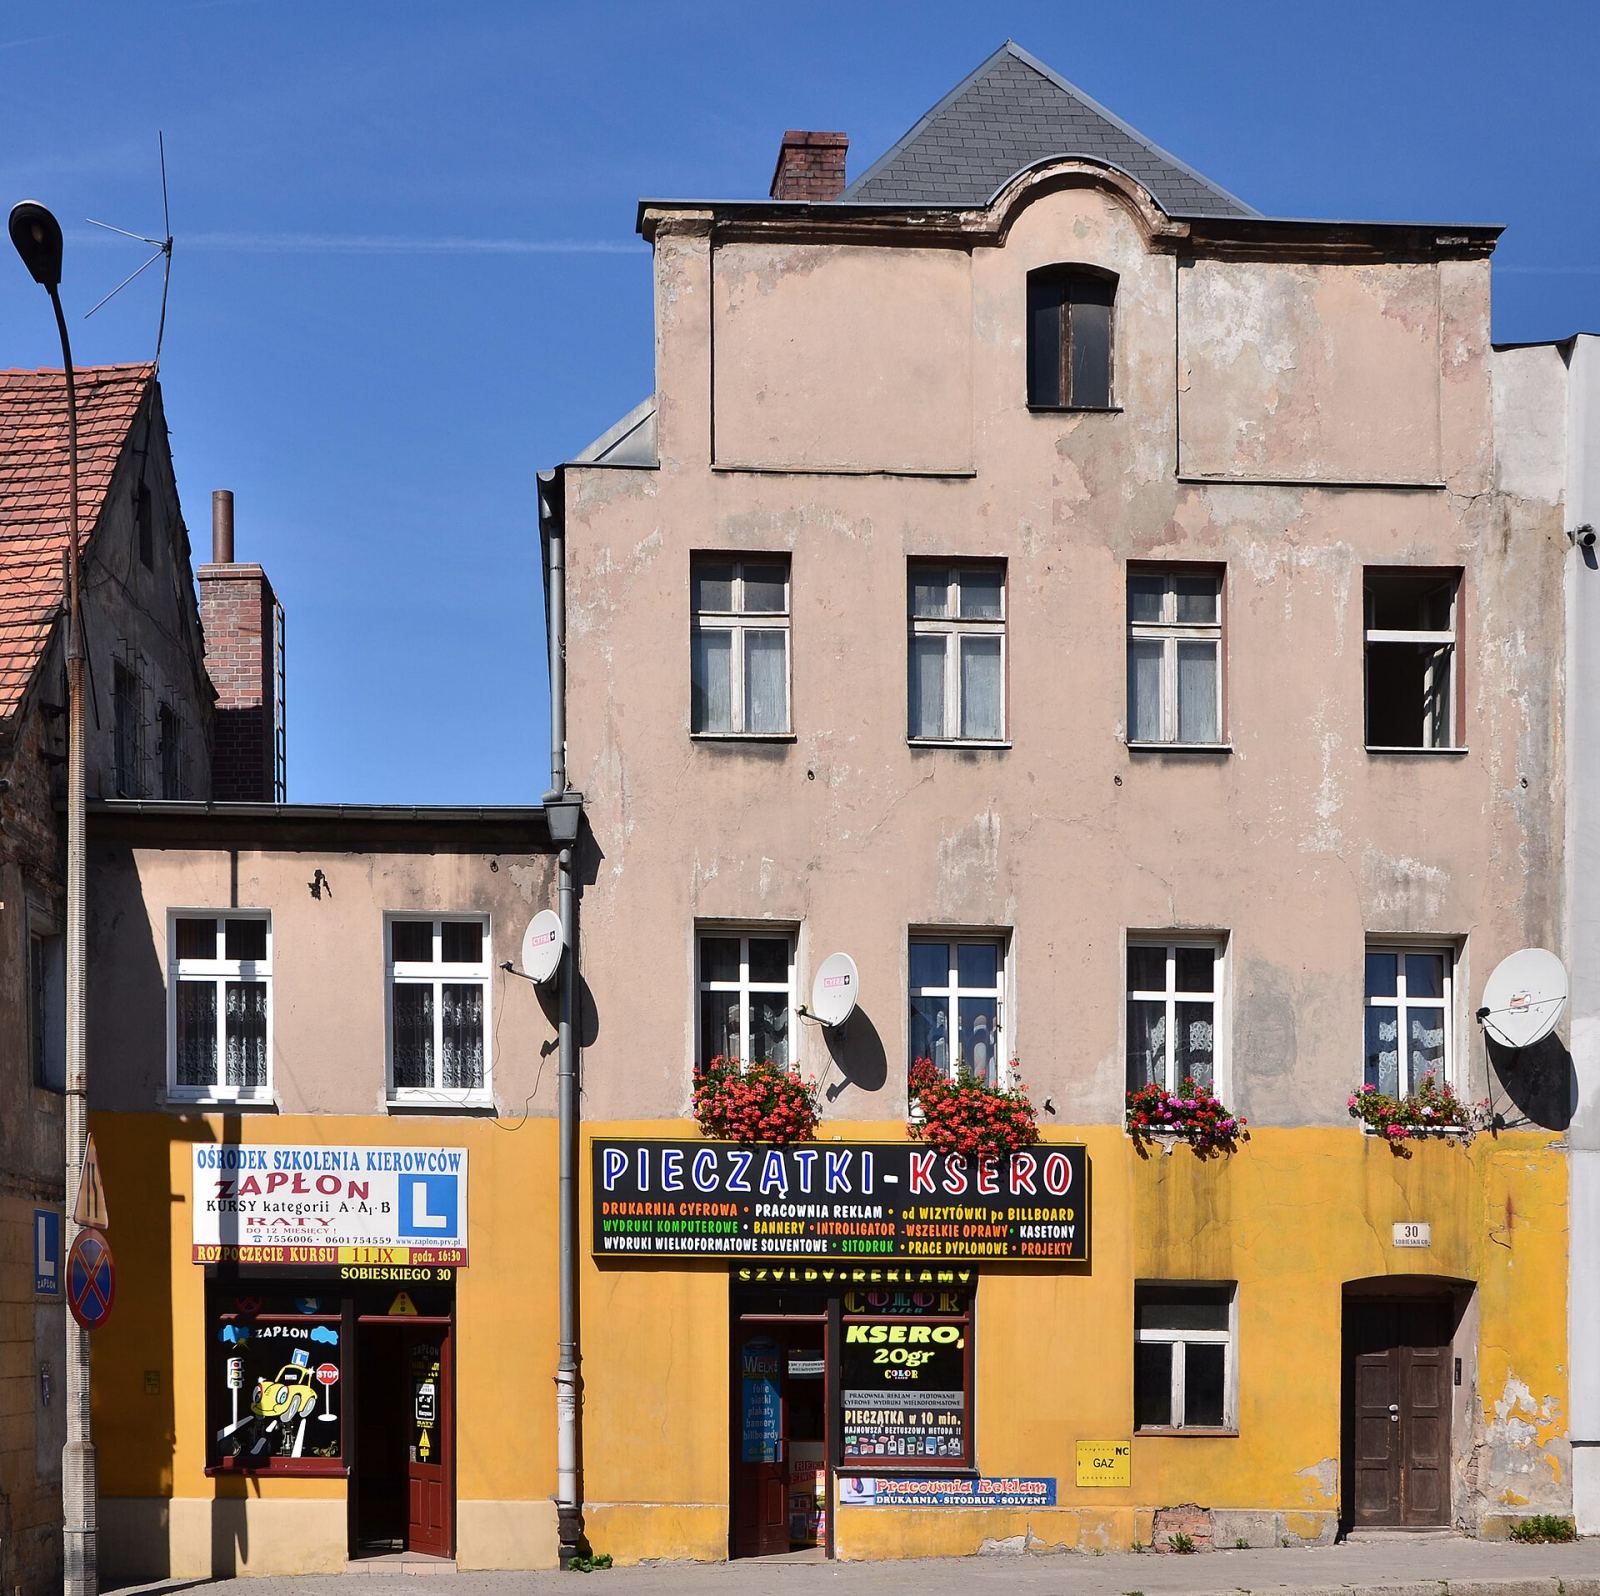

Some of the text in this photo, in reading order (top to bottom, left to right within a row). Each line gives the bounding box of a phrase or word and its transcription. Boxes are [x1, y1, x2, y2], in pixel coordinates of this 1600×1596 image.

[197, 1145, 461, 1173] OŚRODEK SZKOLENIA KIEROWCÓW
[603, 1148, 874, 1199] PIECZĄTKI
[909, 1150, 1073, 1196] KSERO
[214, 1172, 370, 1201] ZAPŁON
[206, 1200, 257, 1213] KURSY
[263, 1200, 330, 1216] kategorii
[602, 1202, 1075, 1223] DRUKARNIA CYFROWA PRACOWNIA REKLAM od WIZYTÓWKI po BILLBOARD
[246, 1217, 336, 1227] RATY
[602, 1220, 653, 1233] WYDRUKI
[657, 1220, 738, 1234] KOMPUTEROWE
[753, 1221, 805, 1234] BANNERY
[816, 1222, 896, 1236] INTROLIGATOR
[963, 1225, 1008, 1238] OPRAWY
[1019, 1225, 1076, 1239] KASETONY
[267, 1235, 392, 1245] 7556006 0601754559
[1404, 1225, 1418, 1238] 30
[604, 1237, 1073, 1256] WYDRUKI WIELKOFORMATOWE SOLVENTOWE SITODRUK PRACE DYPLOMOWE PROJEKTY
[197, 1246, 284, 1263] ROZPOCZĘCIE
[290, 1247, 336, 1263] KURSU
[412, 1250, 435, 1265] godz.
[438, 1250, 461, 1263] 16:30
[340, 1267, 452, 1281] SOBIESKIEGO 30
[739, 1267, 971, 1284] SZYLDY REKLAMY
[844, 1289, 960, 1313] COLOR
[255, 1325, 309, 1339] ZAPŁON
[846, 1325, 960, 1344] KSERO
[872, 1348, 935, 1367] 20gr
[316, 1370, 338, 1379] STOP
[884, 1369, 919, 1379] COLOR
[844, 1410, 961, 1428] PIECZĄTKA w 10 min.
[844, 1426, 882, 1435] NAJNOWSZA
[884, 1426, 926, 1435] BEZTUSZOWA
[928, 1426, 954, 1435] METODA
[1115, 1447, 1129, 1456] NC
[1093, 1458, 1115, 1469] GAZ
[876, 1478, 1048, 1495] Pracownia Reklam
[876, 1496, 1048, 1505] DRUKARNIA SITODRUK SOLVENT
